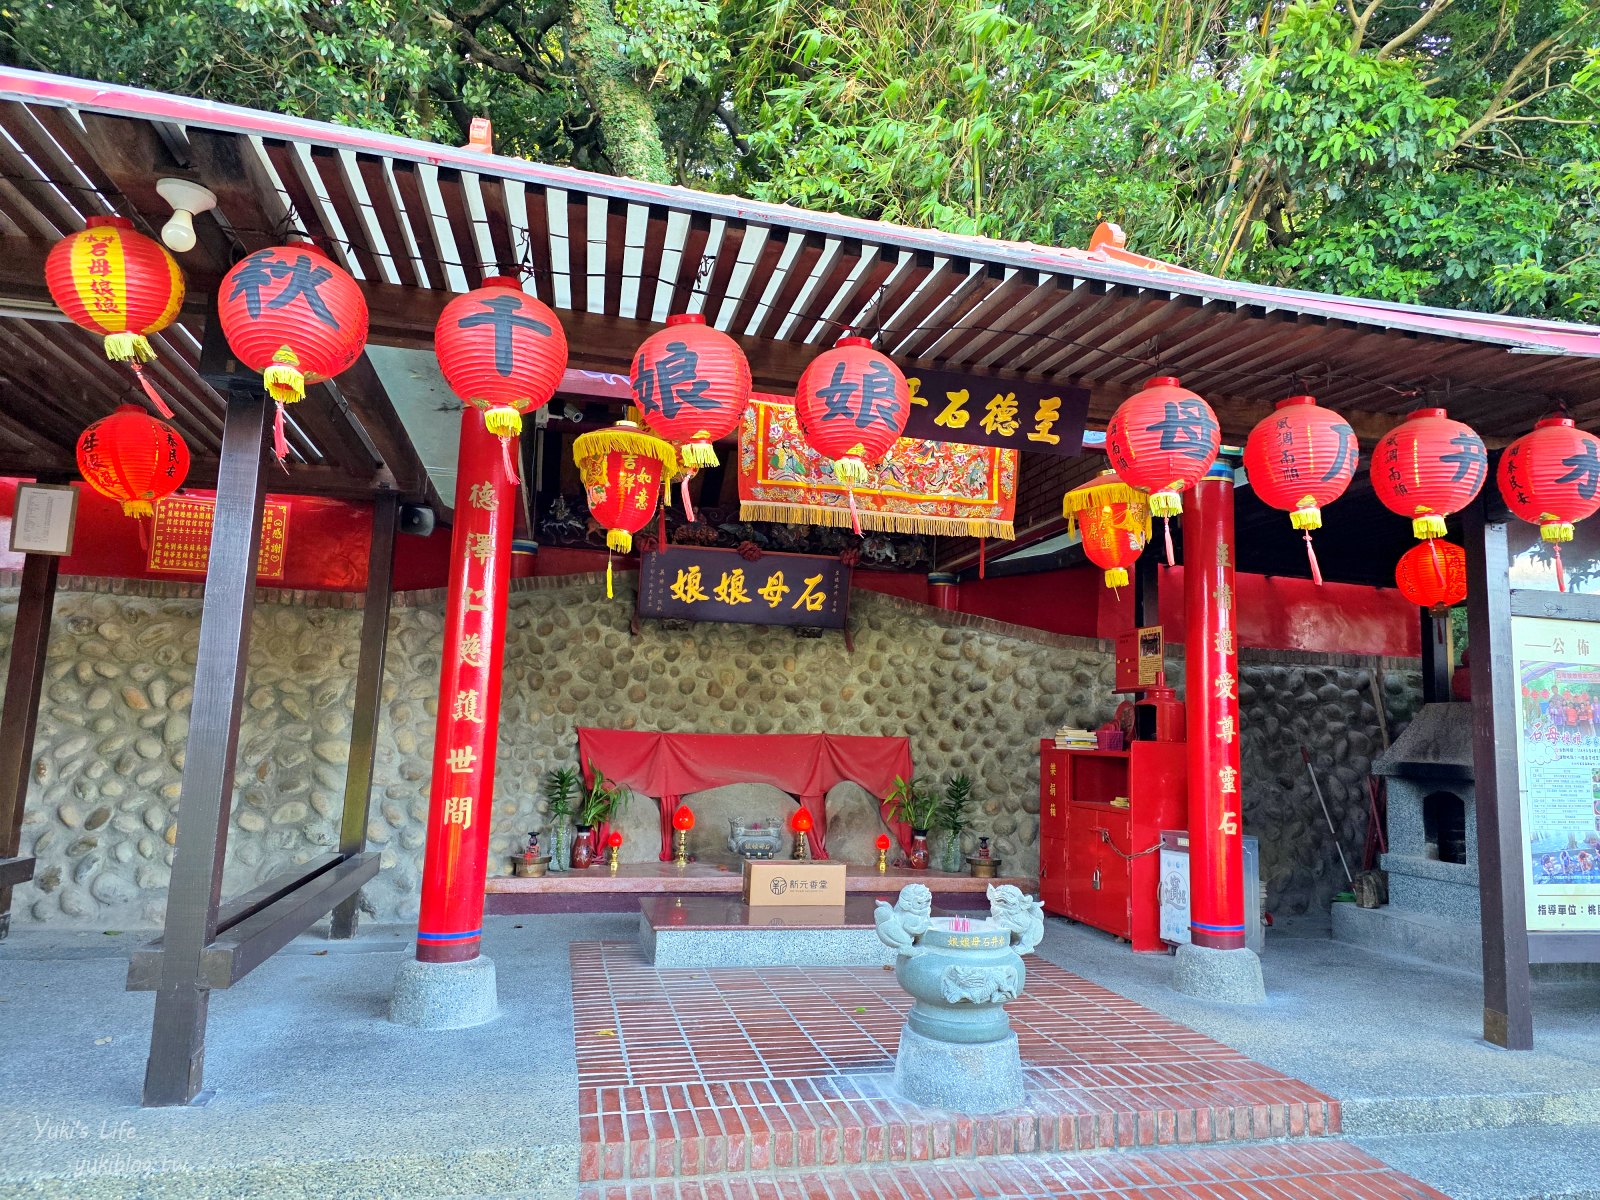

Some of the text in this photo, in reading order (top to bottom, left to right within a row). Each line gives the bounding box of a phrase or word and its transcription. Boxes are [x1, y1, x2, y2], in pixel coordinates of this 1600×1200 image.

[87, 242, 122, 314] 石母娘娘
[228, 250, 340, 331] 秋
[458, 294, 553, 378] 千
[632, 341, 724, 420] 娘
[815, 360, 900, 432] 娘
[1145, 398, 1220, 461] 母
[1275, 416, 1302, 482] 風調雨順
[618, 453, 639, 495] 吉祥
[634, 466, 652, 511] 如意
[1384, 433, 1409, 497] 風調雨順
[1439, 432, 1488, 497] 井
[669, 565, 828, 612] 石母娘娘
[443, 480, 500, 831] 德澤仁慈護世間
[789, 879, 828, 889] 新元香堂
[1537, 903, 1600, 916] 指導單位：桃
